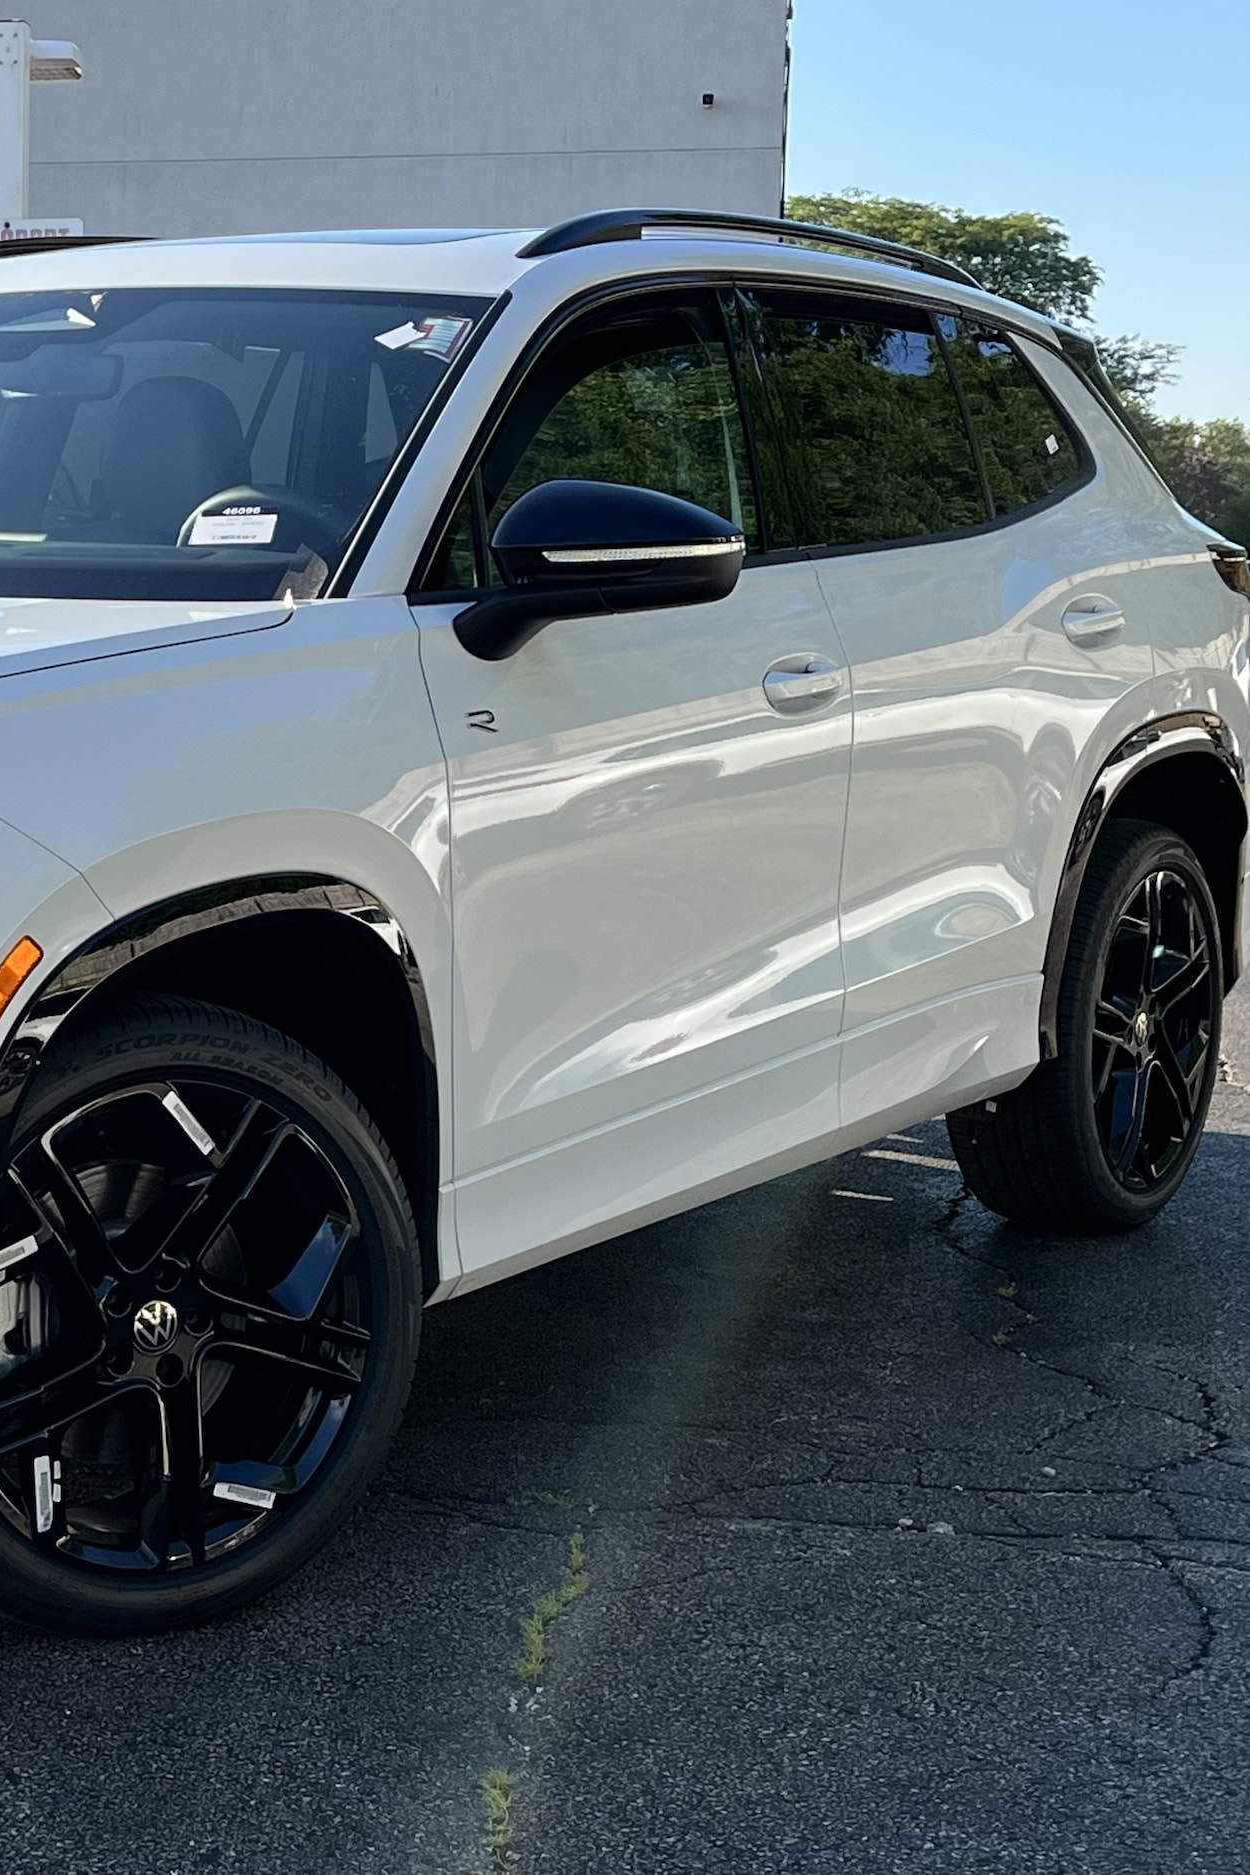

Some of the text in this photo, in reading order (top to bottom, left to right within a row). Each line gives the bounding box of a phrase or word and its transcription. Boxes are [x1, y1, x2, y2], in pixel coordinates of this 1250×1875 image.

[95, 1032, 332, 1102] SCORPION ZERO
[170, 1051, 200, 1063] ALL
